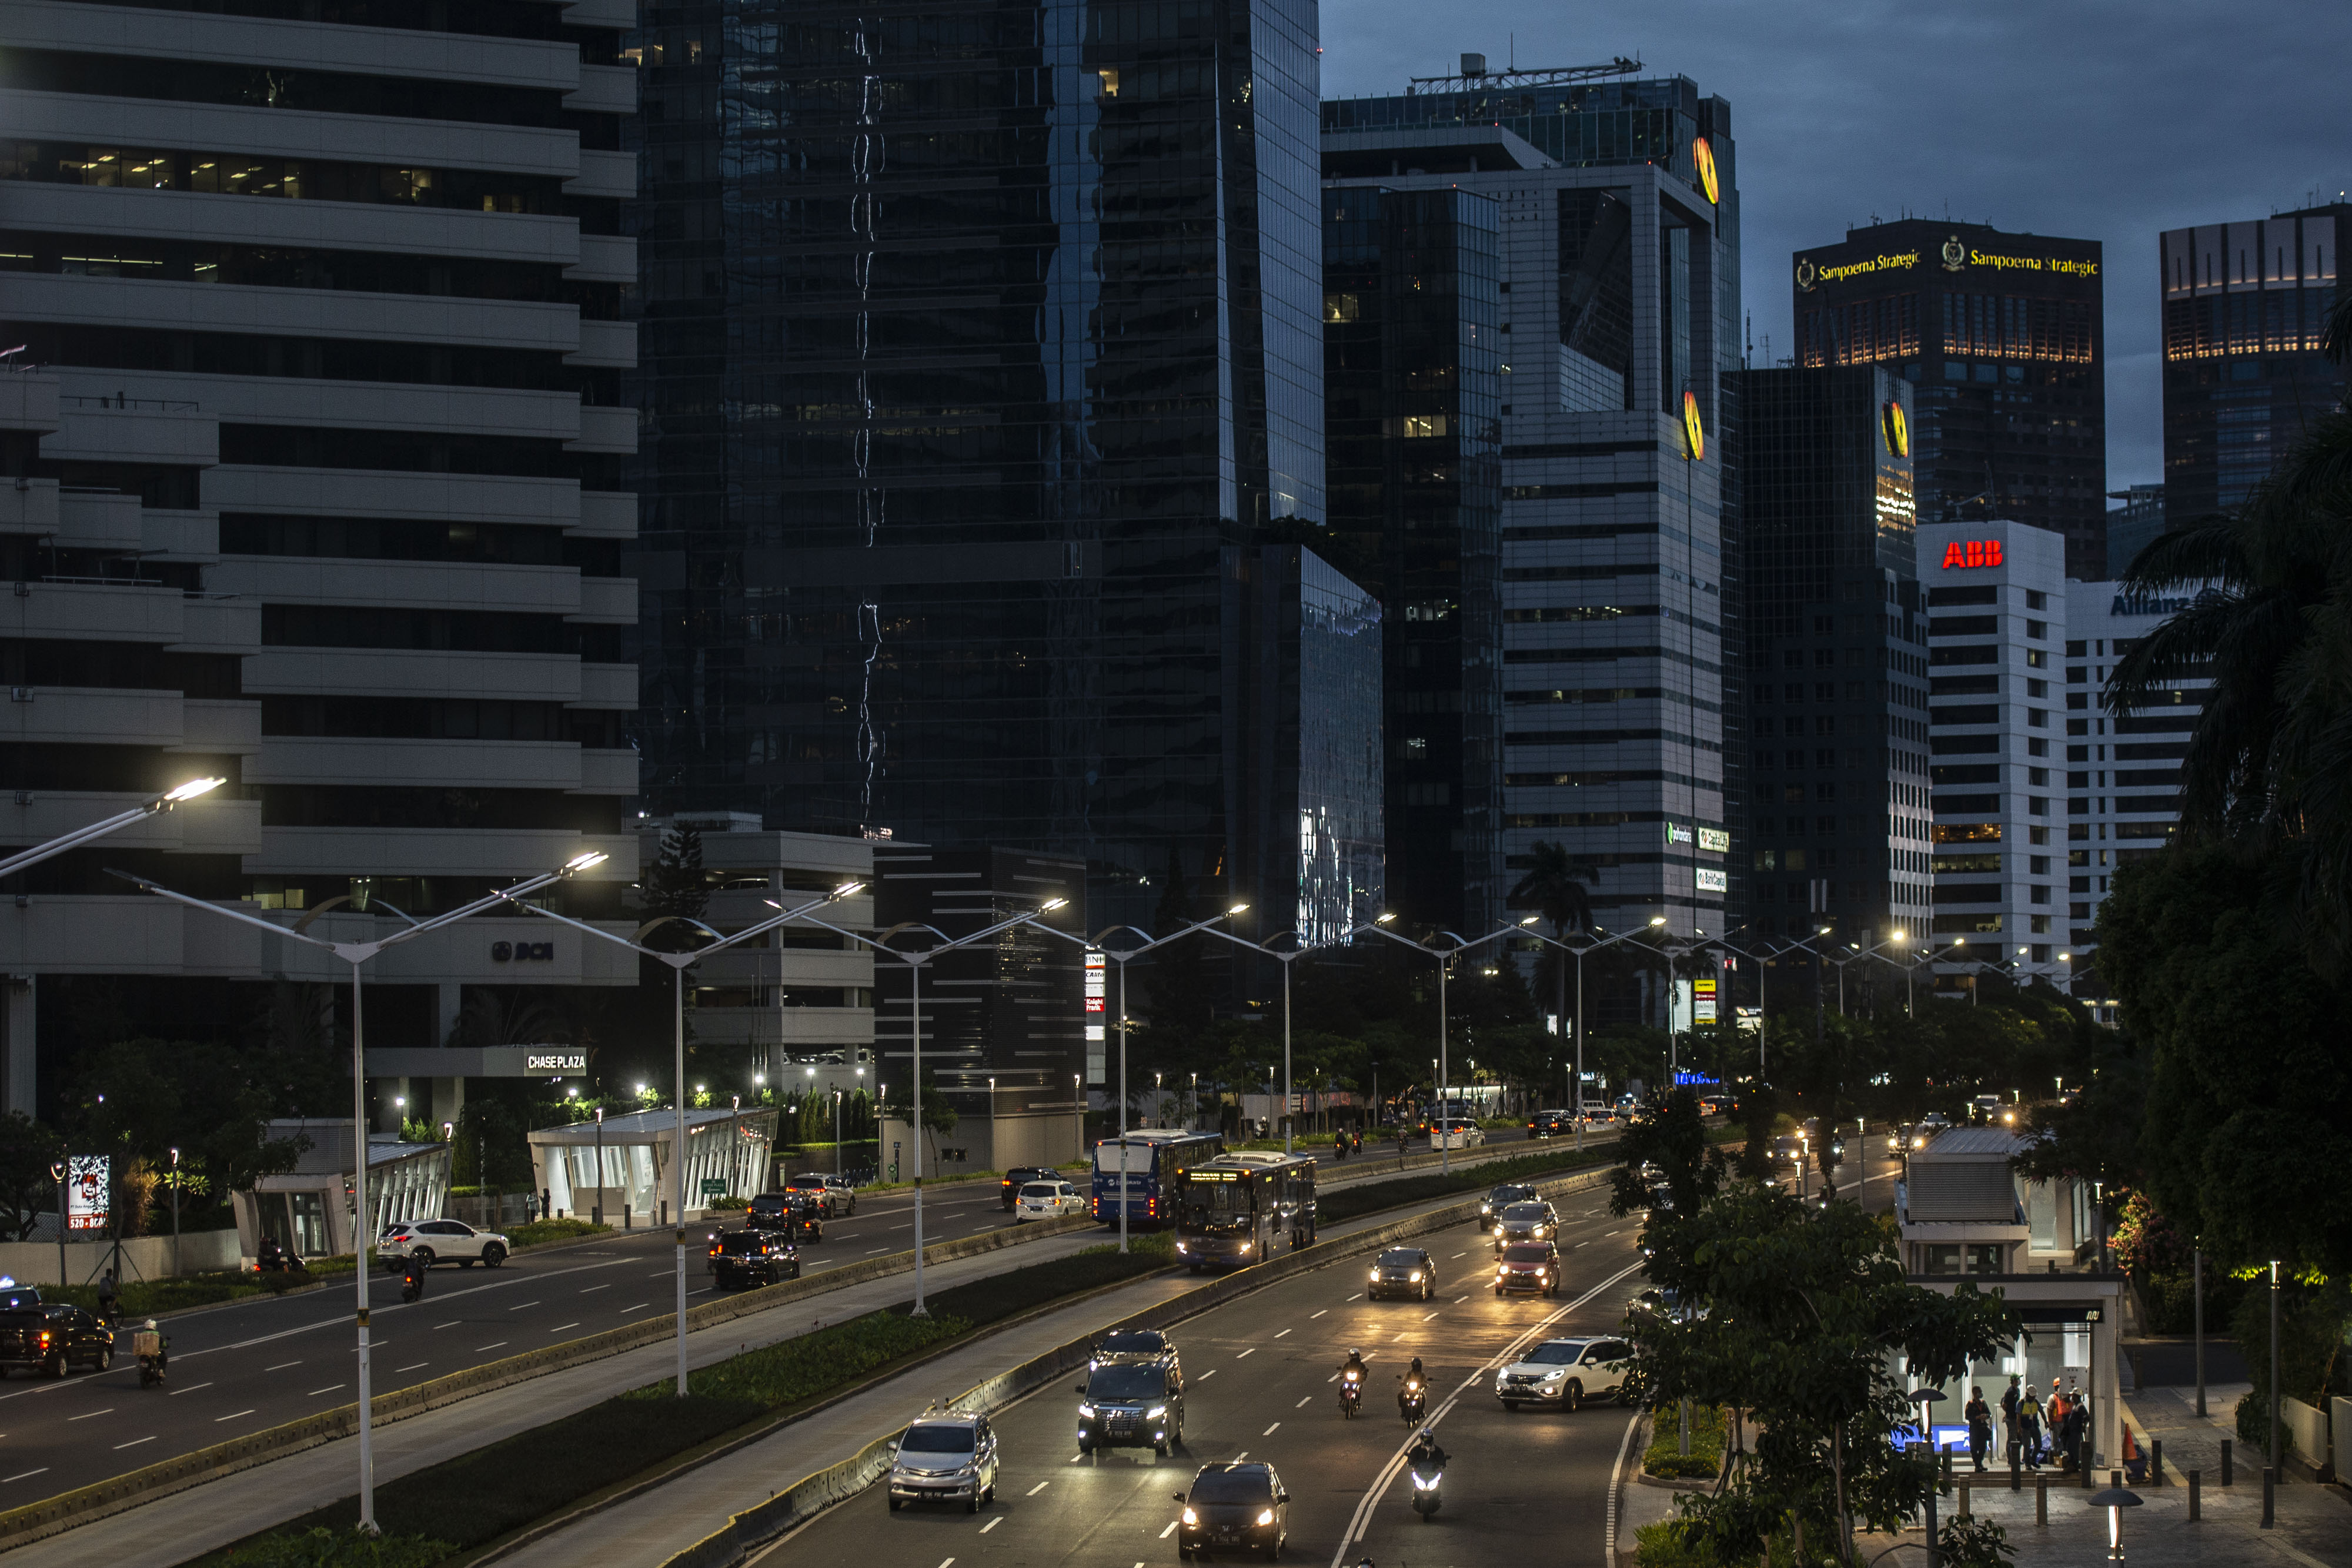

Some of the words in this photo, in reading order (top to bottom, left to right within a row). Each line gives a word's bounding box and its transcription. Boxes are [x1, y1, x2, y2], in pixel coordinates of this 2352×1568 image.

[1819, 259, 1875, 282] Sampoerna
[1877, 249, 1921, 269] Strategic
[1970, 249, 2042, 270] Sampoerna
[2045, 256, 2098, 278] Strategic
[1942, 540, 2003, 569] ABB
[515, 942, 553, 959] BCA
[528, 1056, 556, 1069] CHASE
[557, 1056, 585, 1069] PLAZA
[70, 1218, 84, 1228] 520
